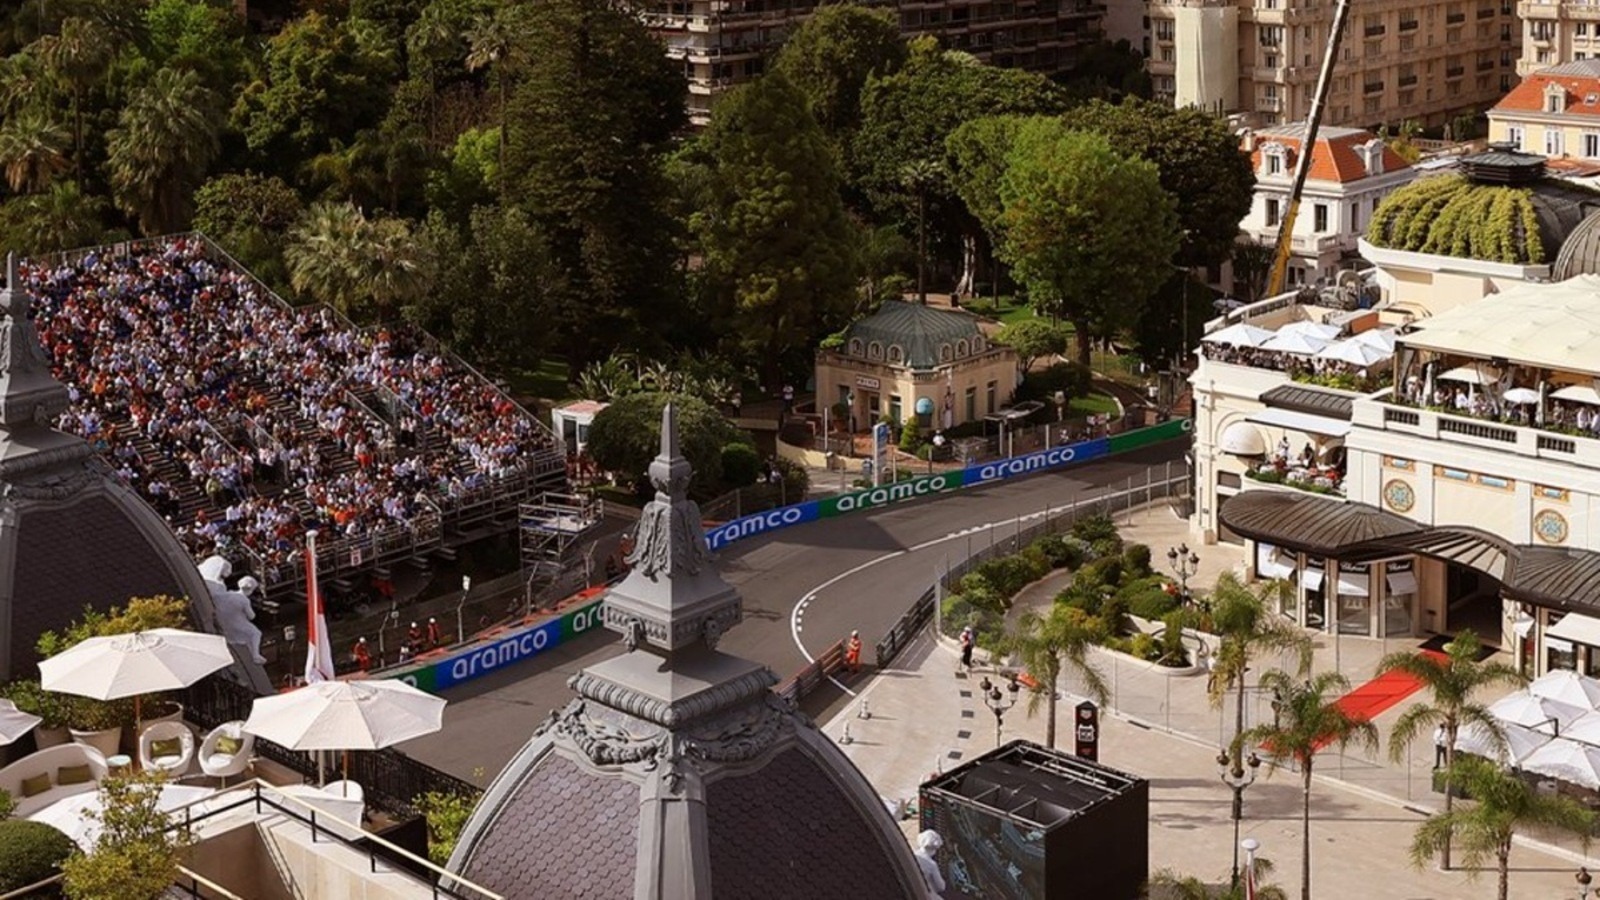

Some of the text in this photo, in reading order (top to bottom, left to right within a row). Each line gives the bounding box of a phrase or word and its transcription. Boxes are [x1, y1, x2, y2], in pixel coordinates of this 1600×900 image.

[980, 448, 1075, 480] aramco
[836, 476, 946, 511] aramco
[452, 629, 548, 679] aramco
